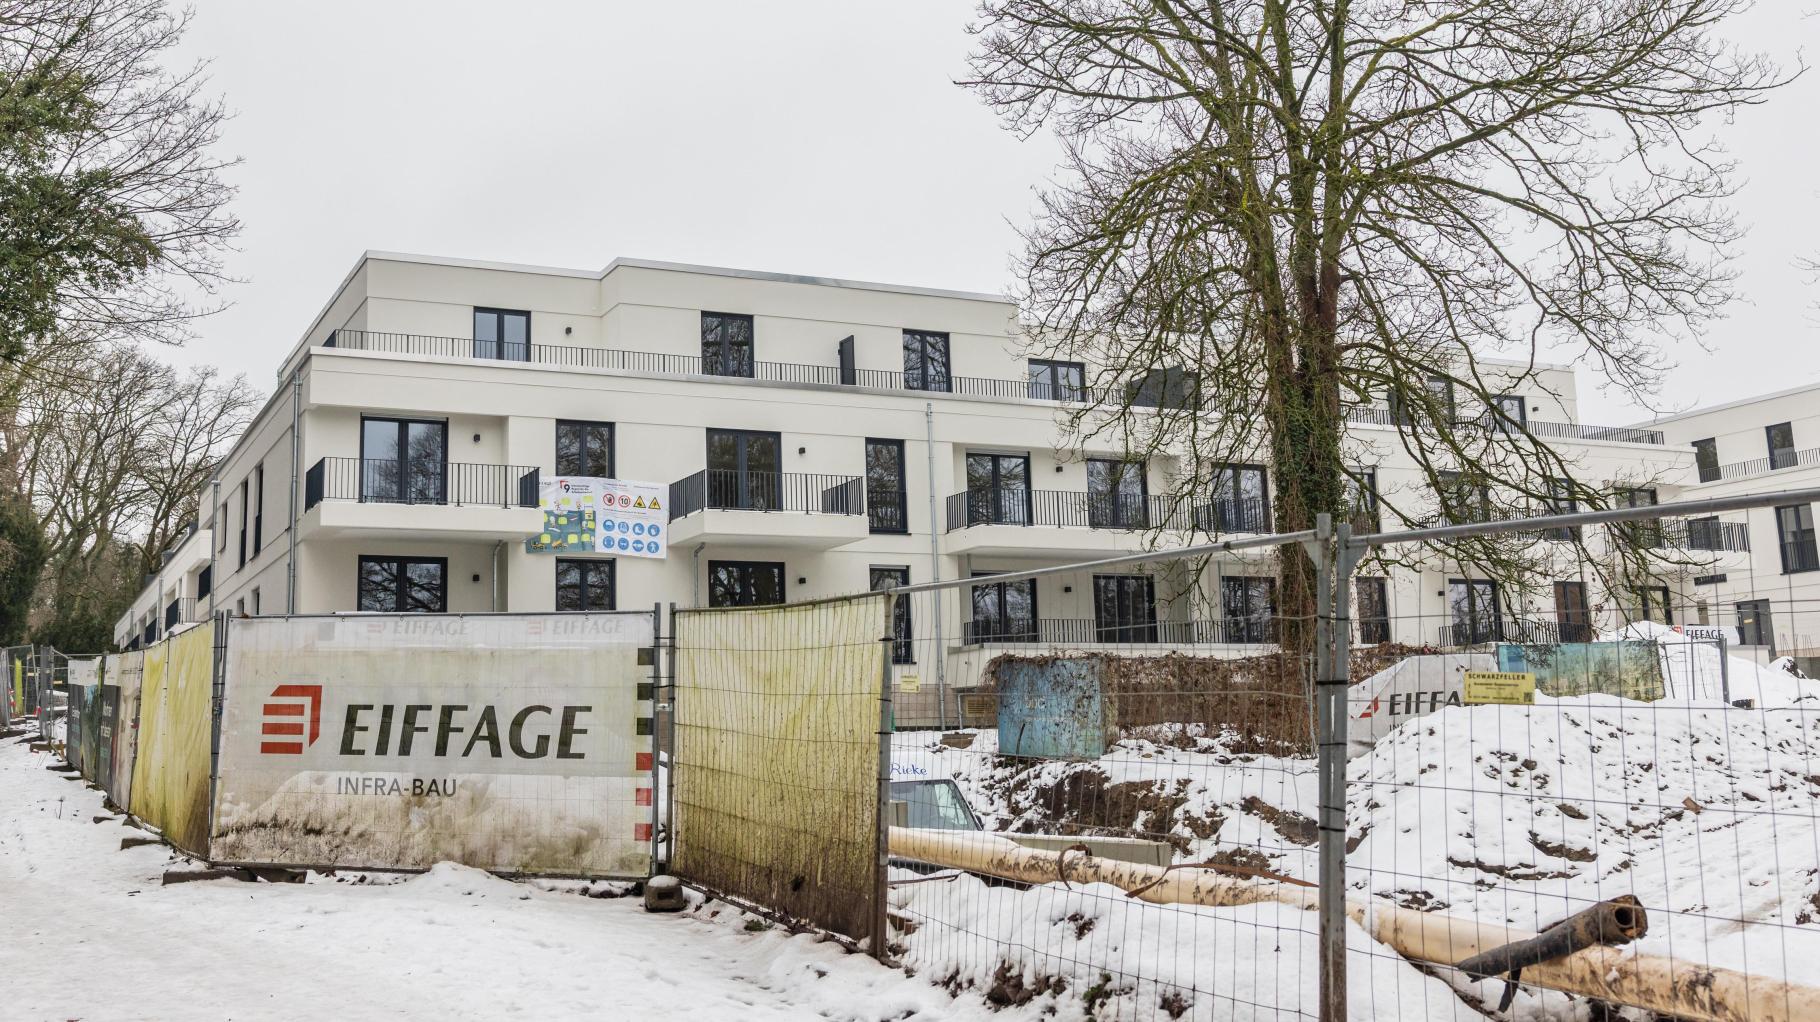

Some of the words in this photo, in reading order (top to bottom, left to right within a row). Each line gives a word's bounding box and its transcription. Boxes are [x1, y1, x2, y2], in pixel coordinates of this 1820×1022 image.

[564, 484, 571, 494] 9
[392, 619, 468, 636] EIFFAGE
[552, 617, 625, 635] EIFFAGE
[1388, 690, 1463, 716] EIFFA
[339, 704, 593, 760] EIFFAGE
[337, 777, 458, 798] INFRA-BAU
